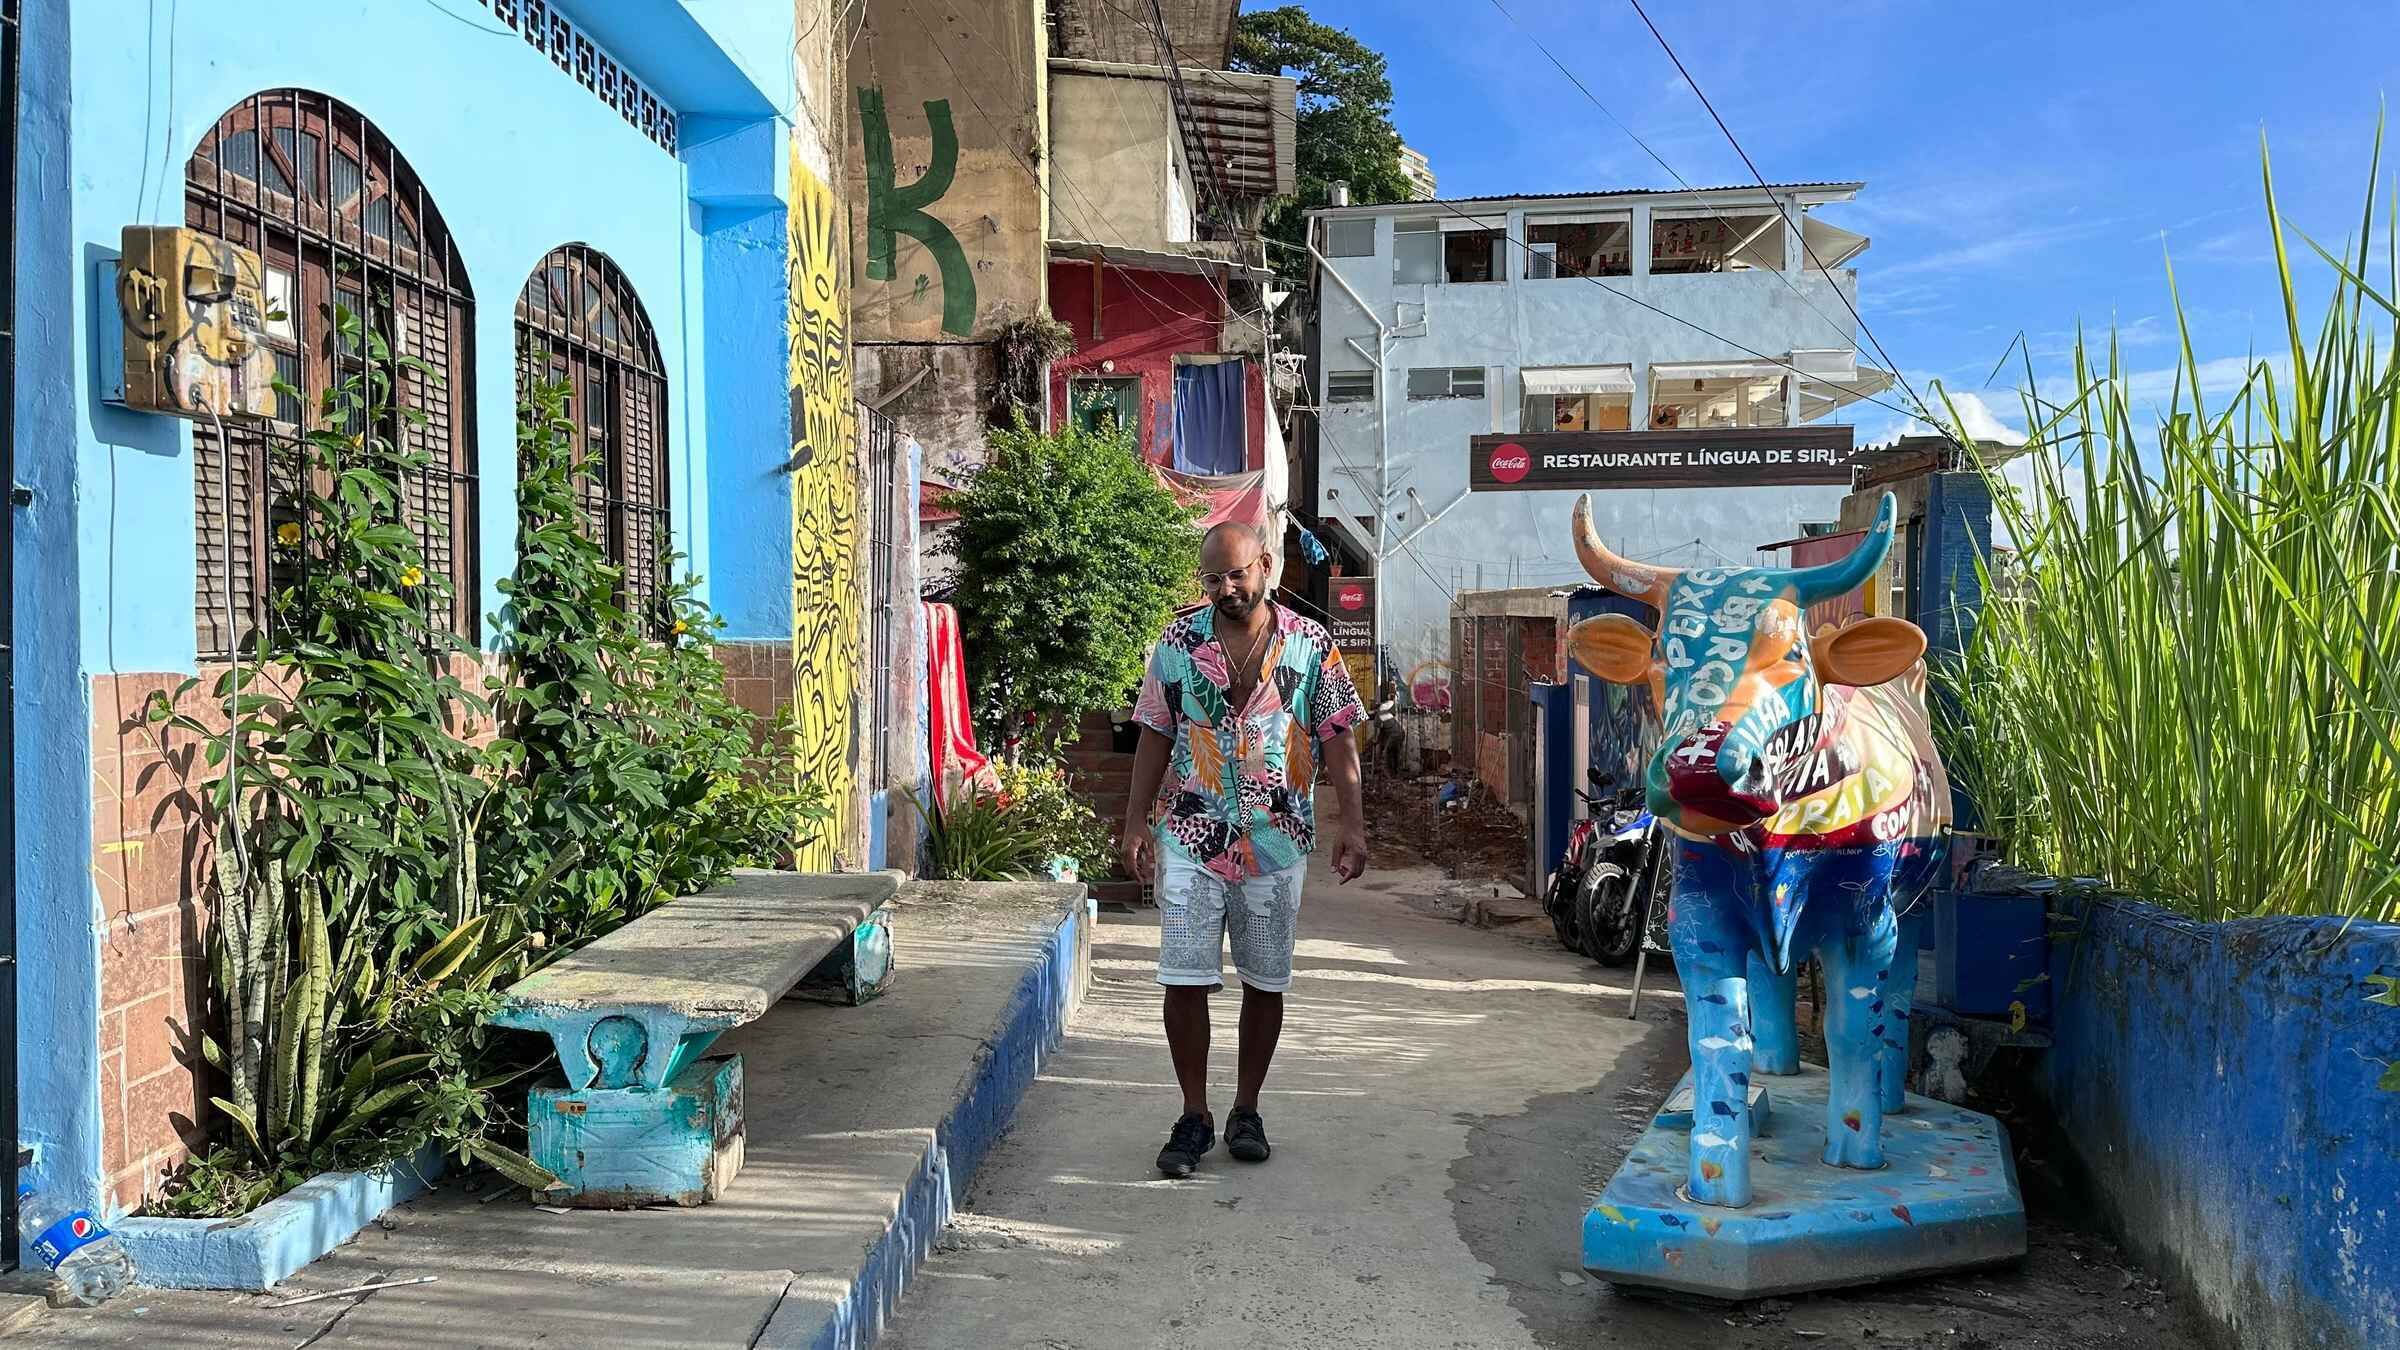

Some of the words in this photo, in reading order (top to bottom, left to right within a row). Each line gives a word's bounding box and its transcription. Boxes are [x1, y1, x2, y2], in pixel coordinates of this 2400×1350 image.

[1543, 452, 1682, 469] RESTAURANTE
[1687, 449, 1761, 466] LÍNGUA
[1766, 450, 1793, 465] DE
[1797, 449, 1835, 465] SIRI
[1333, 627, 1371, 636] LÍNGUA
[1766, 714, 1818, 776] SOLAR
[1775, 767, 1893, 833] PRAIA
